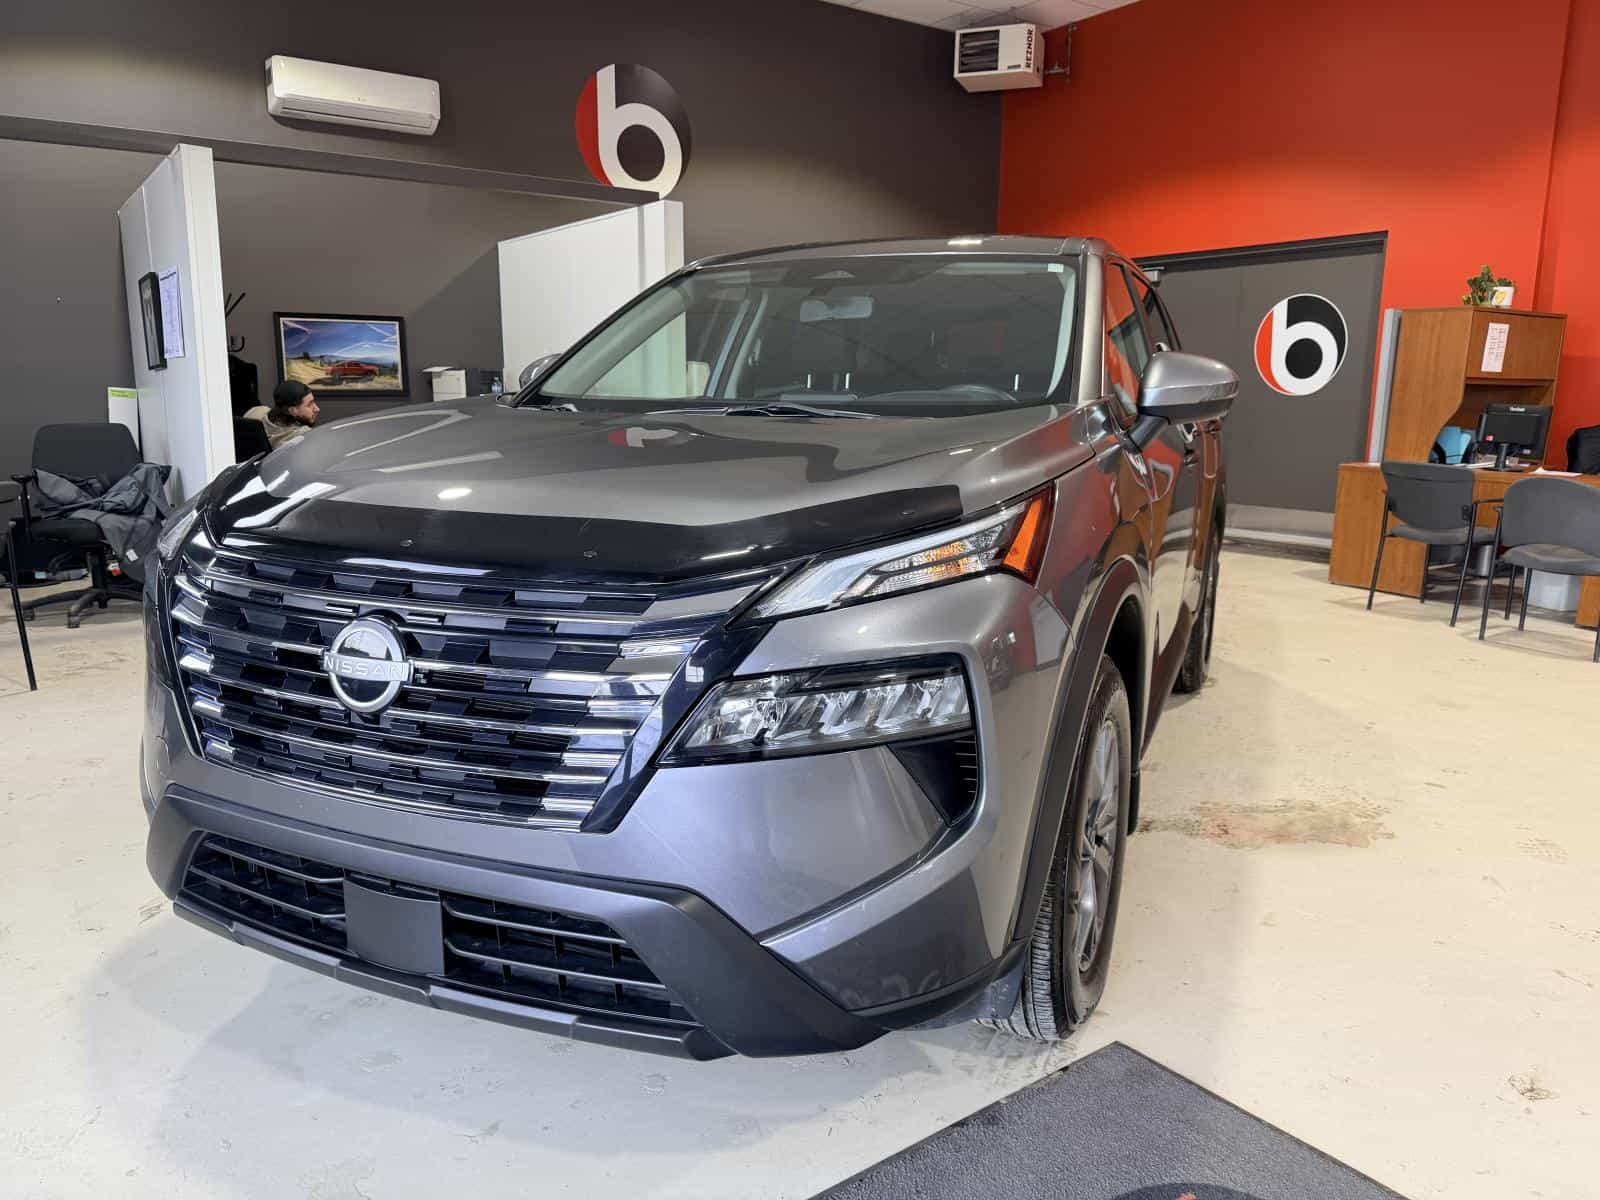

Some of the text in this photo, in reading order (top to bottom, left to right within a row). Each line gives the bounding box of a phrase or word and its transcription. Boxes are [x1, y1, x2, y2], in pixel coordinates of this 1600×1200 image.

[1024, 28, 1034, 69] REZNOR
[596, 63, 683, 200] b
[1270, 297, 1339, 396] b
[323, 654, 405, 681] NISSAN
